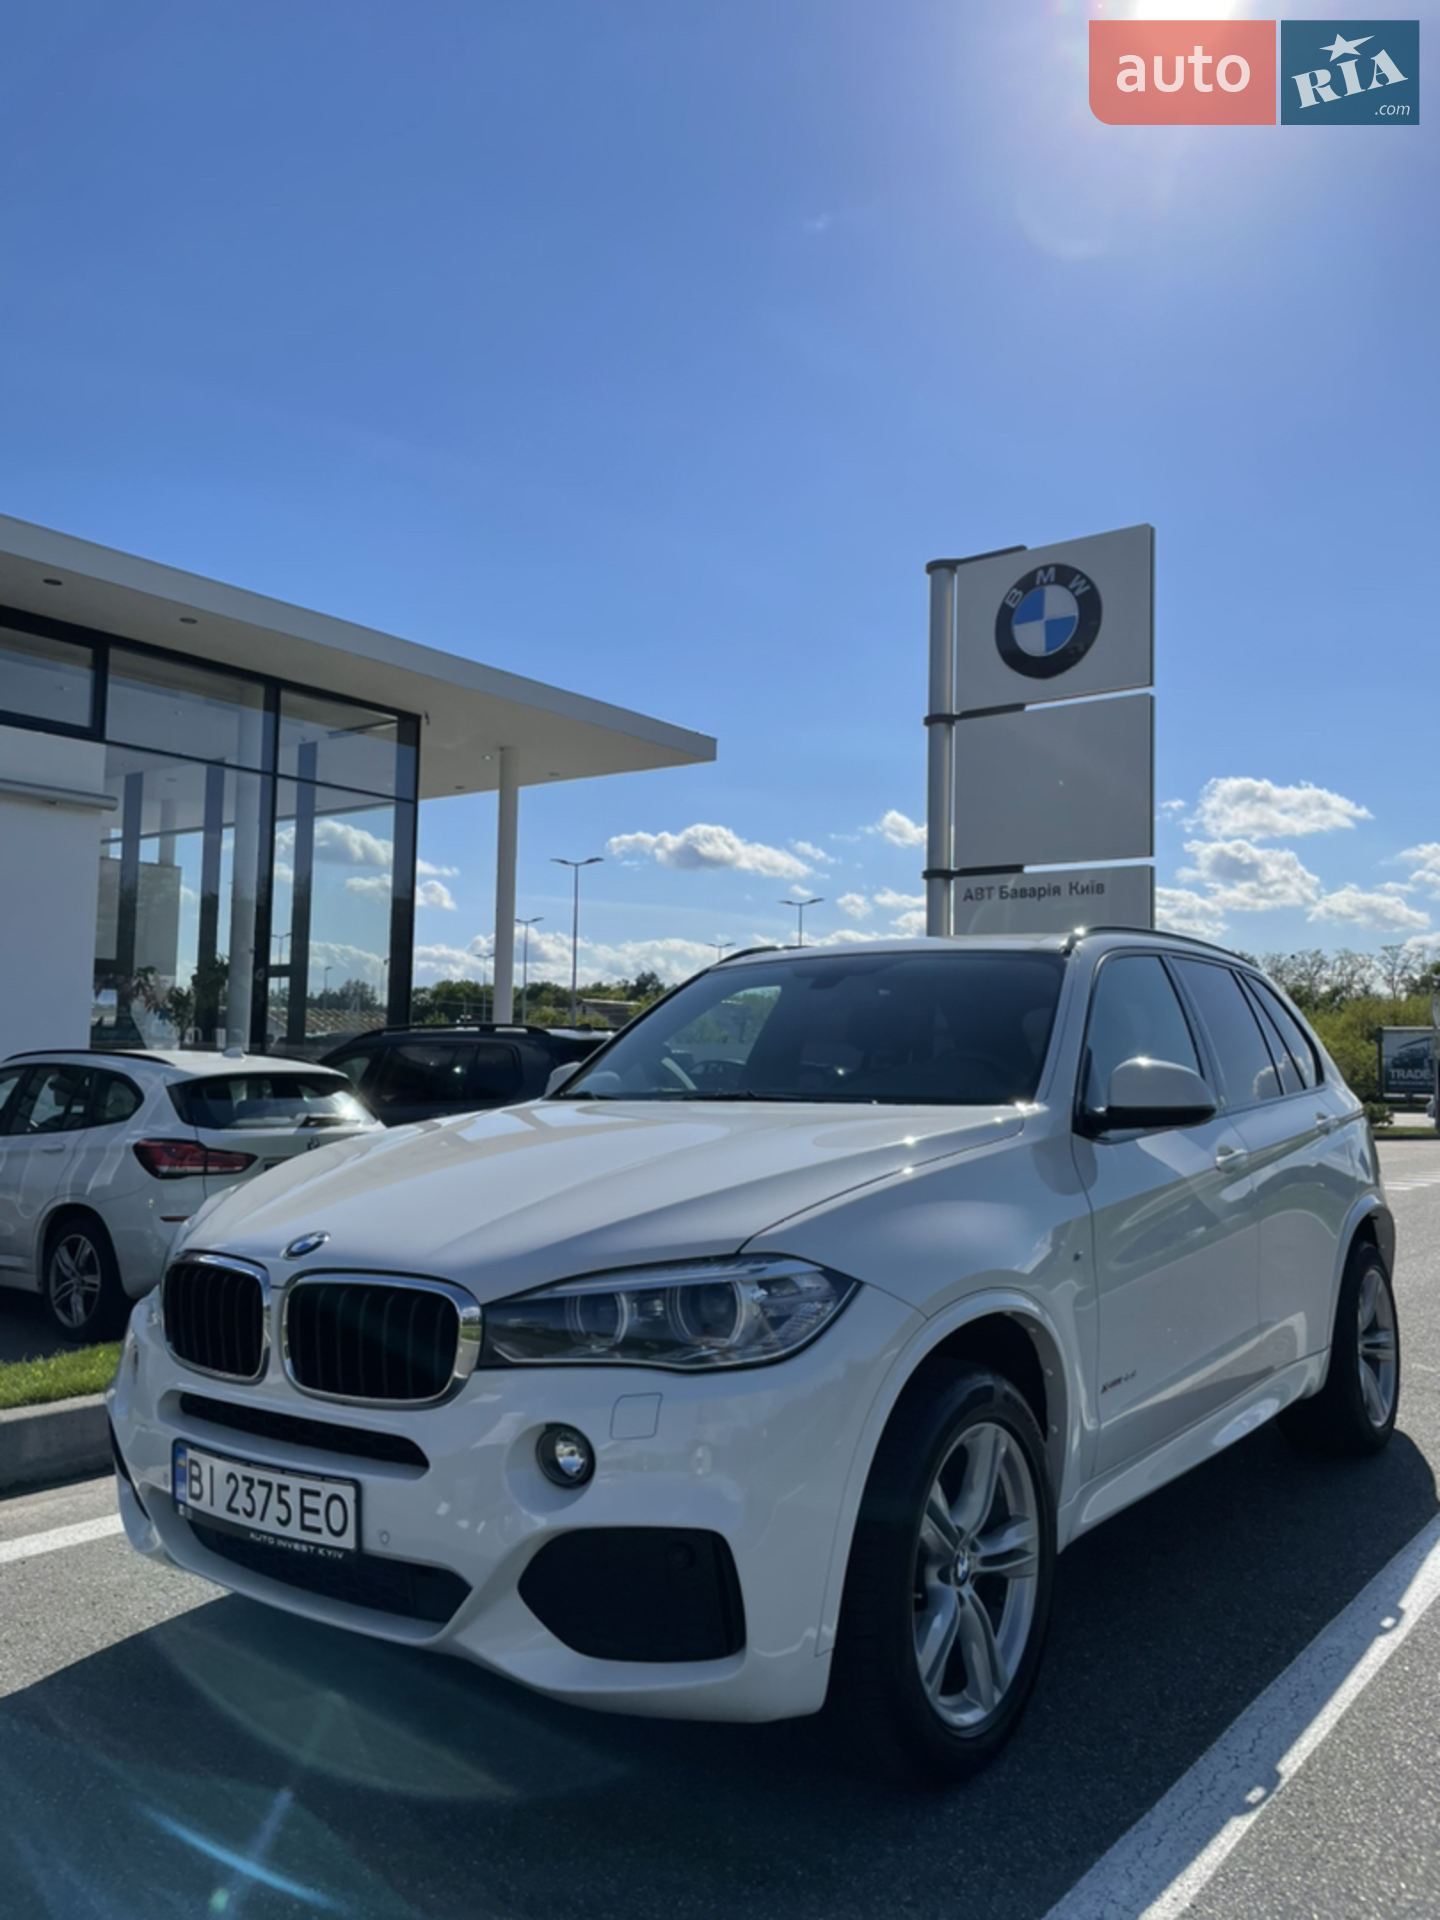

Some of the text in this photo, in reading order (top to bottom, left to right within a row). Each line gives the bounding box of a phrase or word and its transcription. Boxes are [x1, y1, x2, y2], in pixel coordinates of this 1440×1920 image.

[1004, 567, 1090, 608] BMW
[963, 880, 1105, 901] АВТ Баварія Київ
[225, 1471, 292, 1528] 2375
[249, 1532, 344, 1559] AUTO INVEST KYIV
